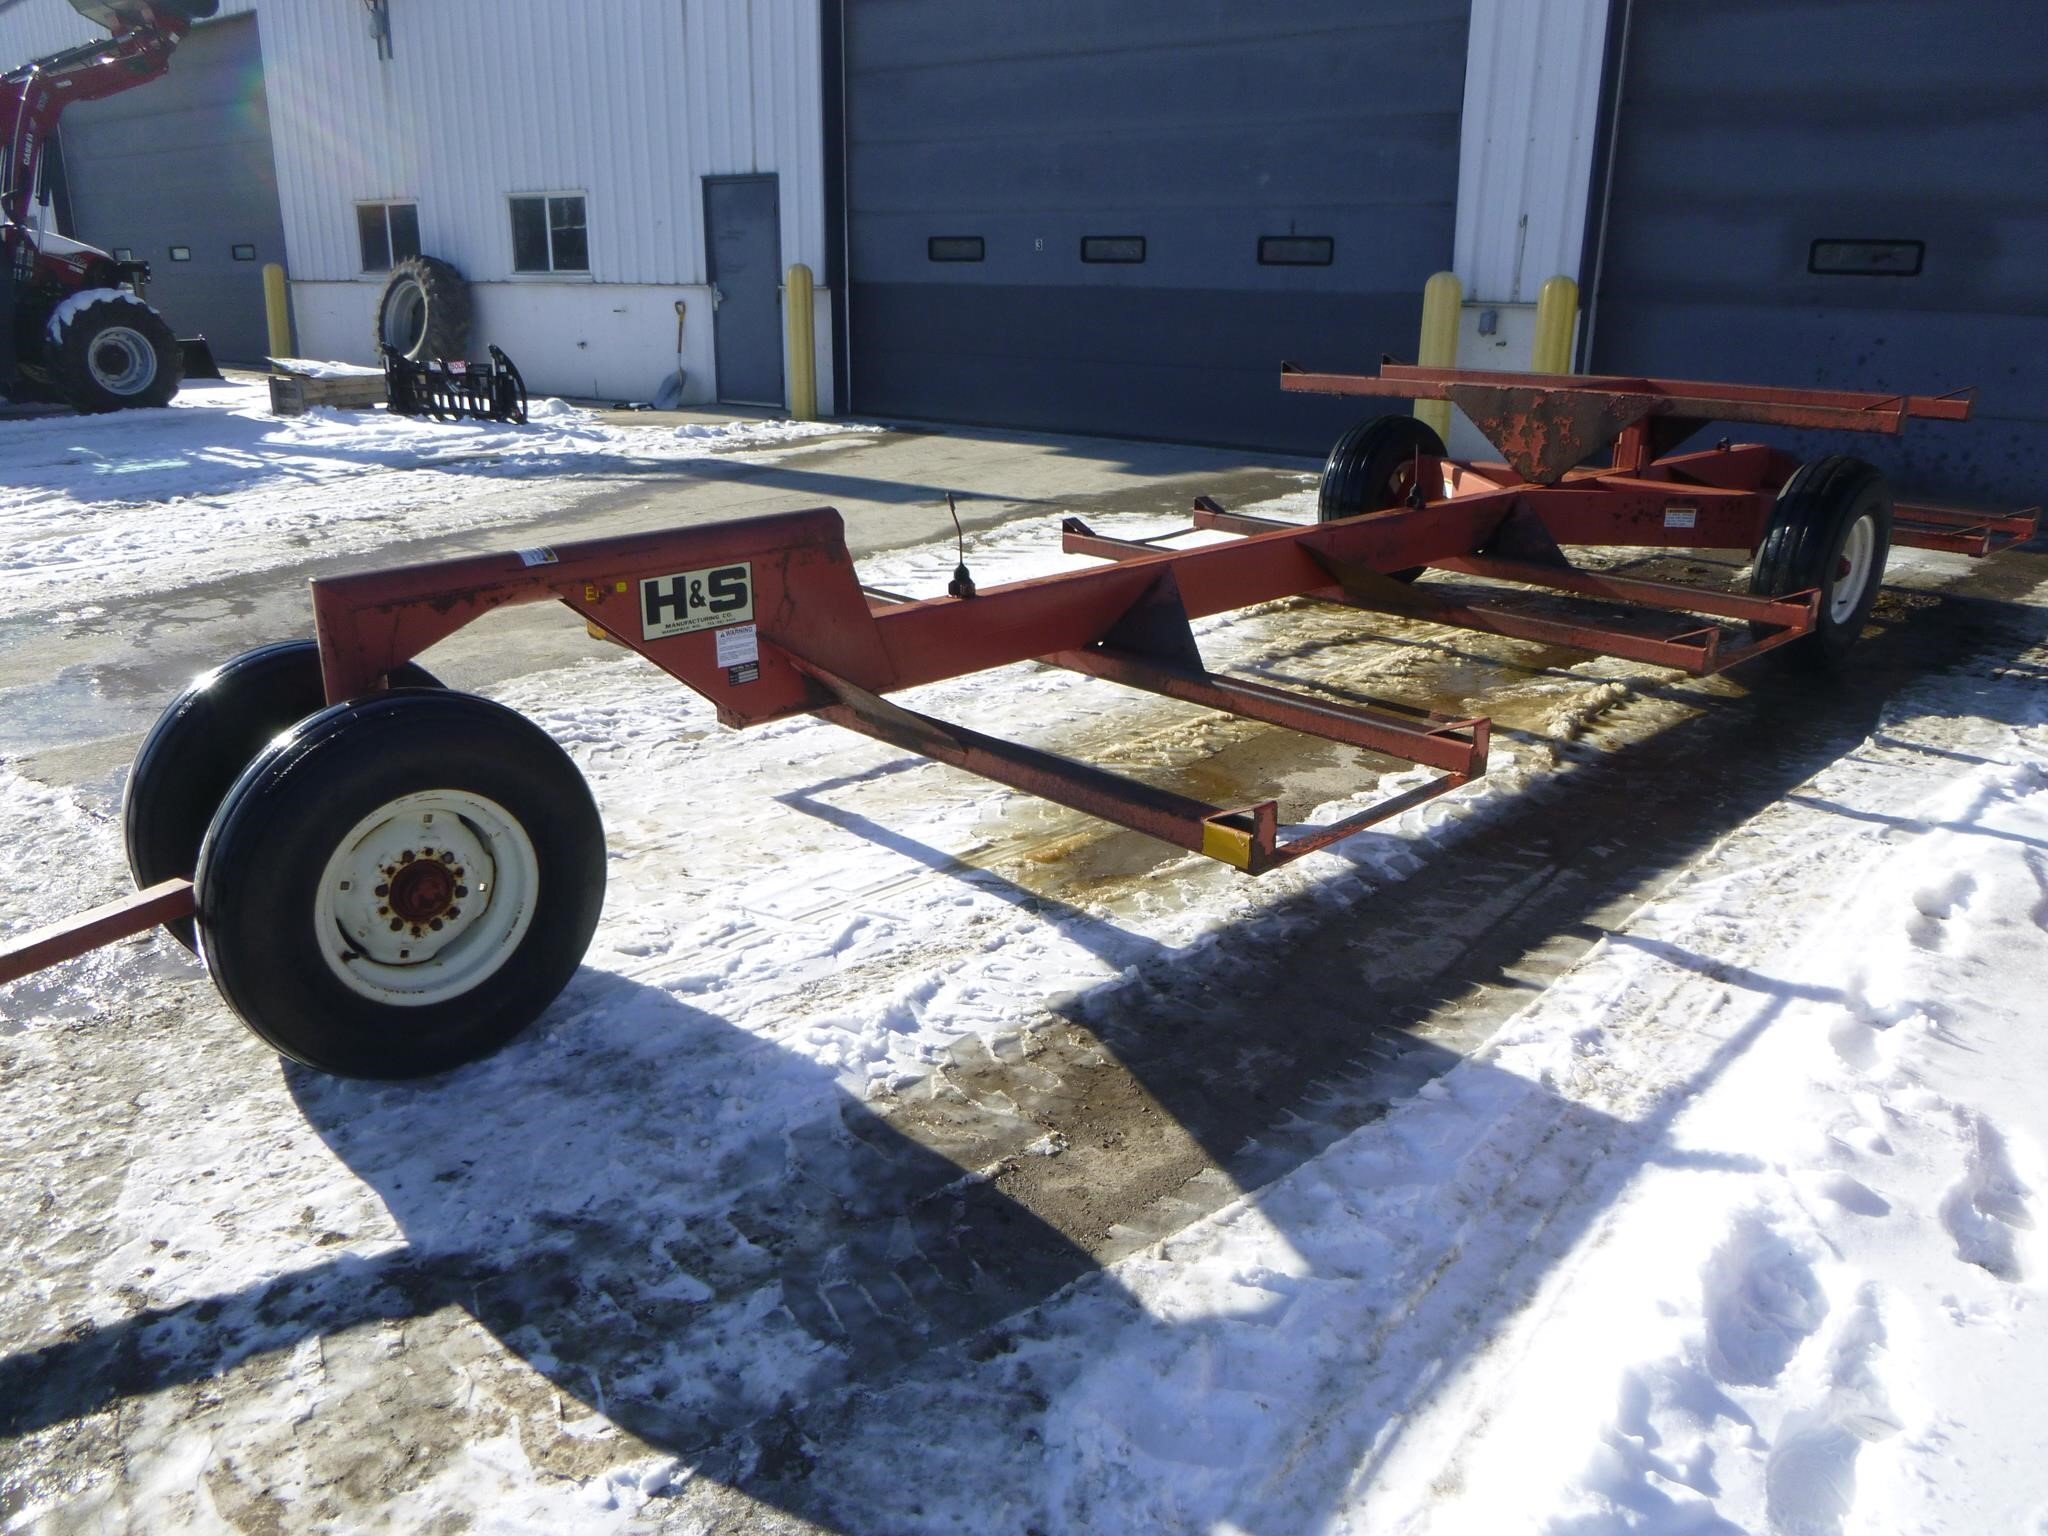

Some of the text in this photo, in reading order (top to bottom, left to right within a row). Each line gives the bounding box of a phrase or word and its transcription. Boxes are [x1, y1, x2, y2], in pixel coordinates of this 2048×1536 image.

[644, 566, 748, 626] H&S
[665, 615, 720, 629] MANUFACTURING
[726, 626, 753, 637] WARNING
